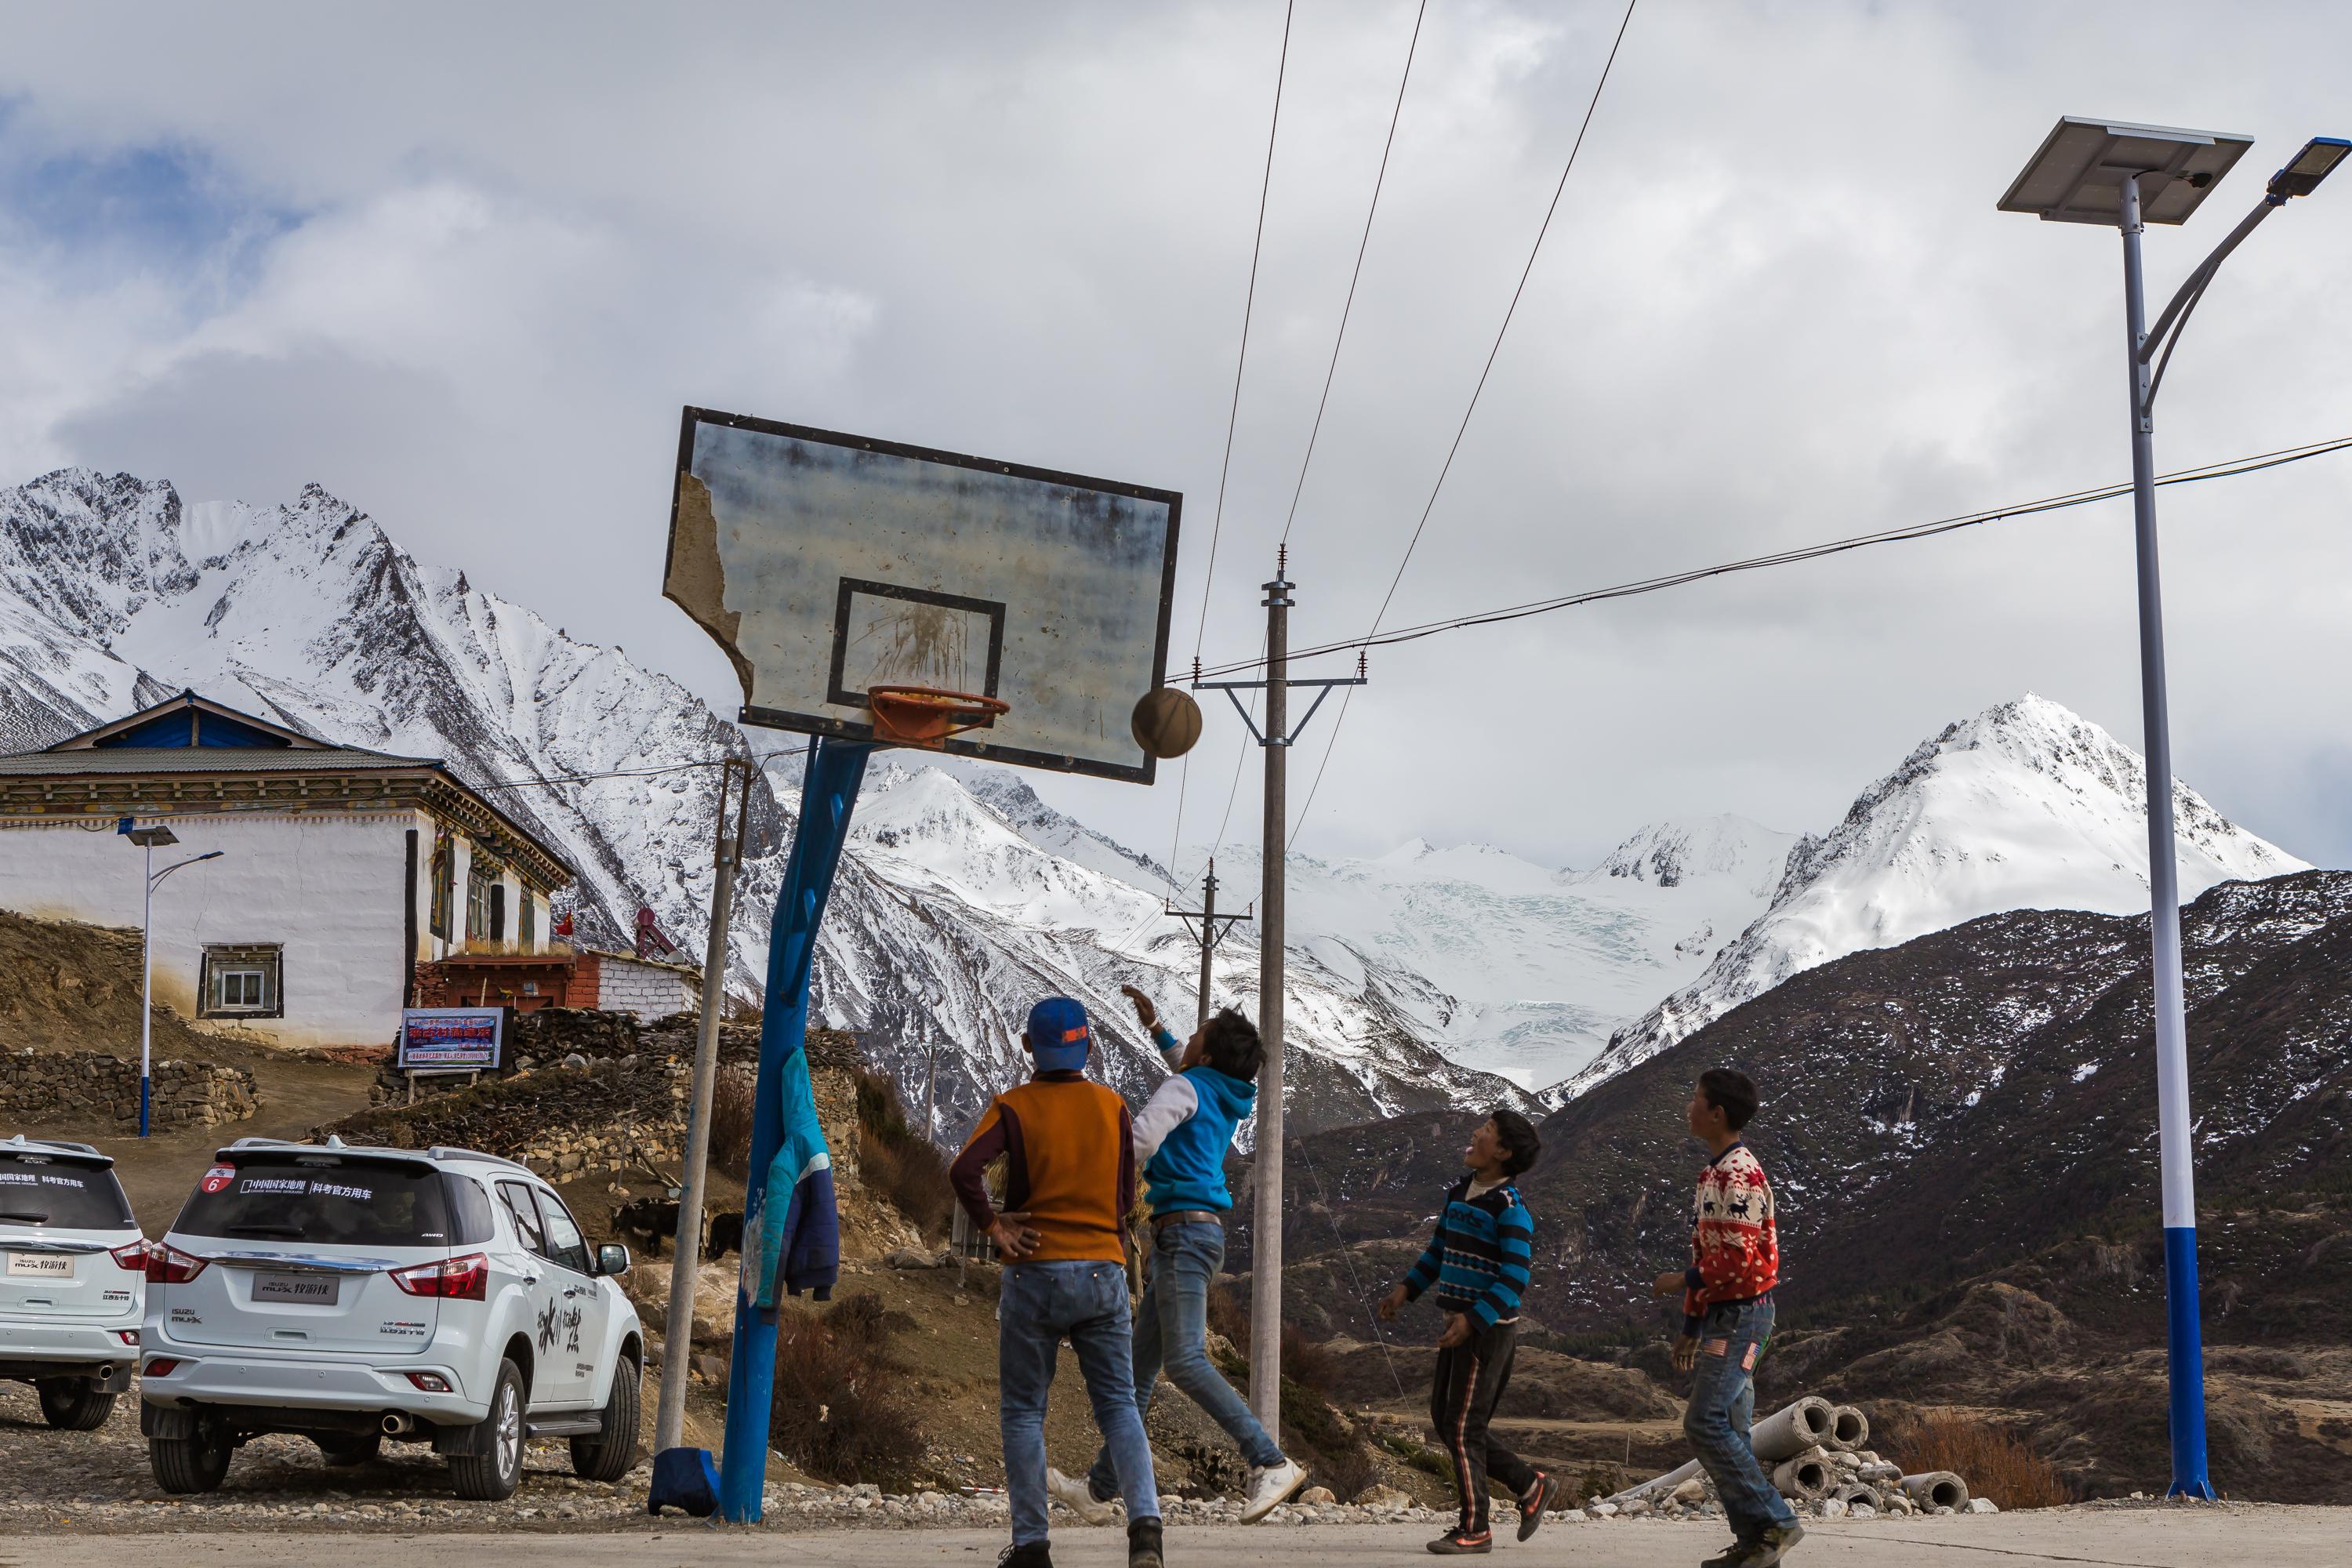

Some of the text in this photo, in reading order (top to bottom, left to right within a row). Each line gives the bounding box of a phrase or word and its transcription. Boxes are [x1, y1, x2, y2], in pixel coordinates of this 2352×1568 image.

[42, 1176, 84, 1188] 科考官方用车
[208, 1178, 220, 1191] 6
[252, 1179, 372, 1200] 中国国家地理 科考官方用车
